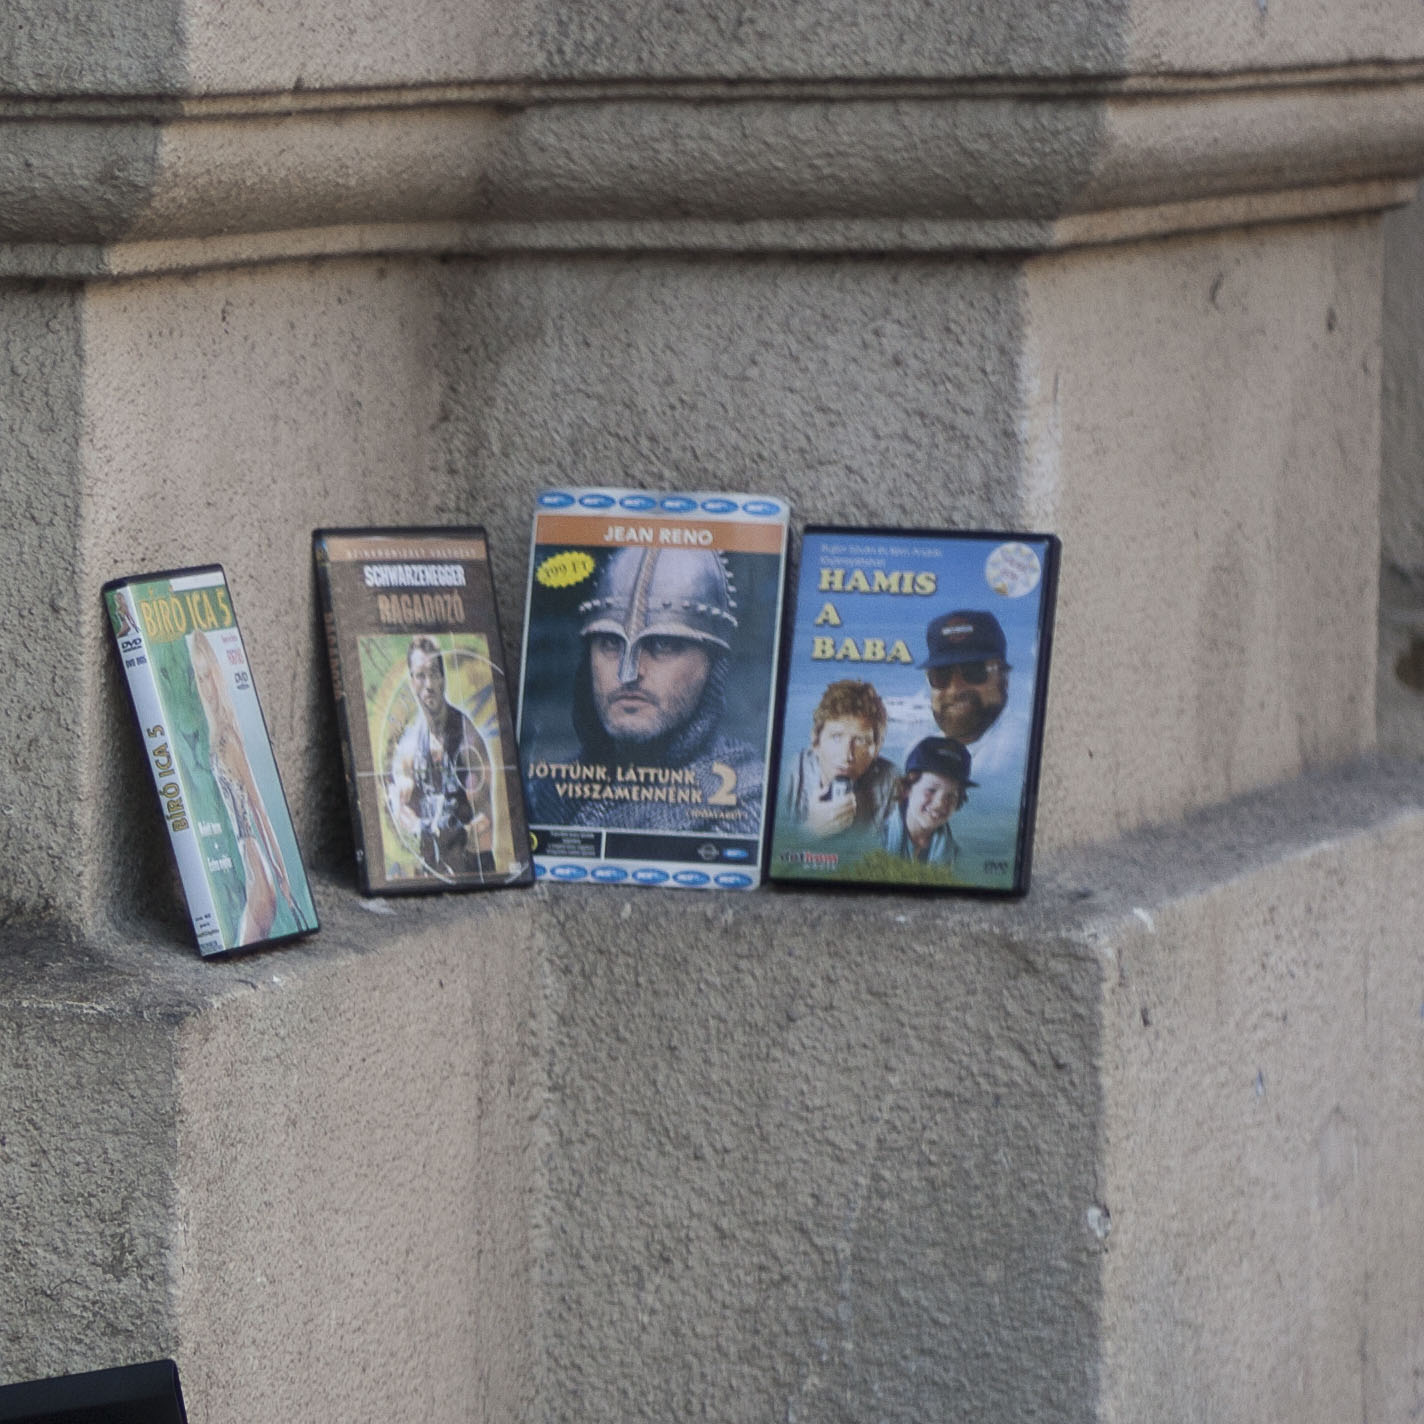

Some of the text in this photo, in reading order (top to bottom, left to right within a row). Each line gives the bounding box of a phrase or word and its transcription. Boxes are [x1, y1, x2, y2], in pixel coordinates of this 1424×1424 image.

[603, 525, 715, 546] JEAN RENO
[362, 563, 468, 588] SCHWARZENEGGER
[818, 567, 938, 596] HAMIS
[184, 590, 220, 630] ICA
[214, 587, 234, 628] 5
[813, 601, 843, 627] A
[811, 635, 915, 665] BABA
[146, 723, 166, 739] 5
[152, 742, 176, 779] ICA
[706, 760, 738, 806] 2
